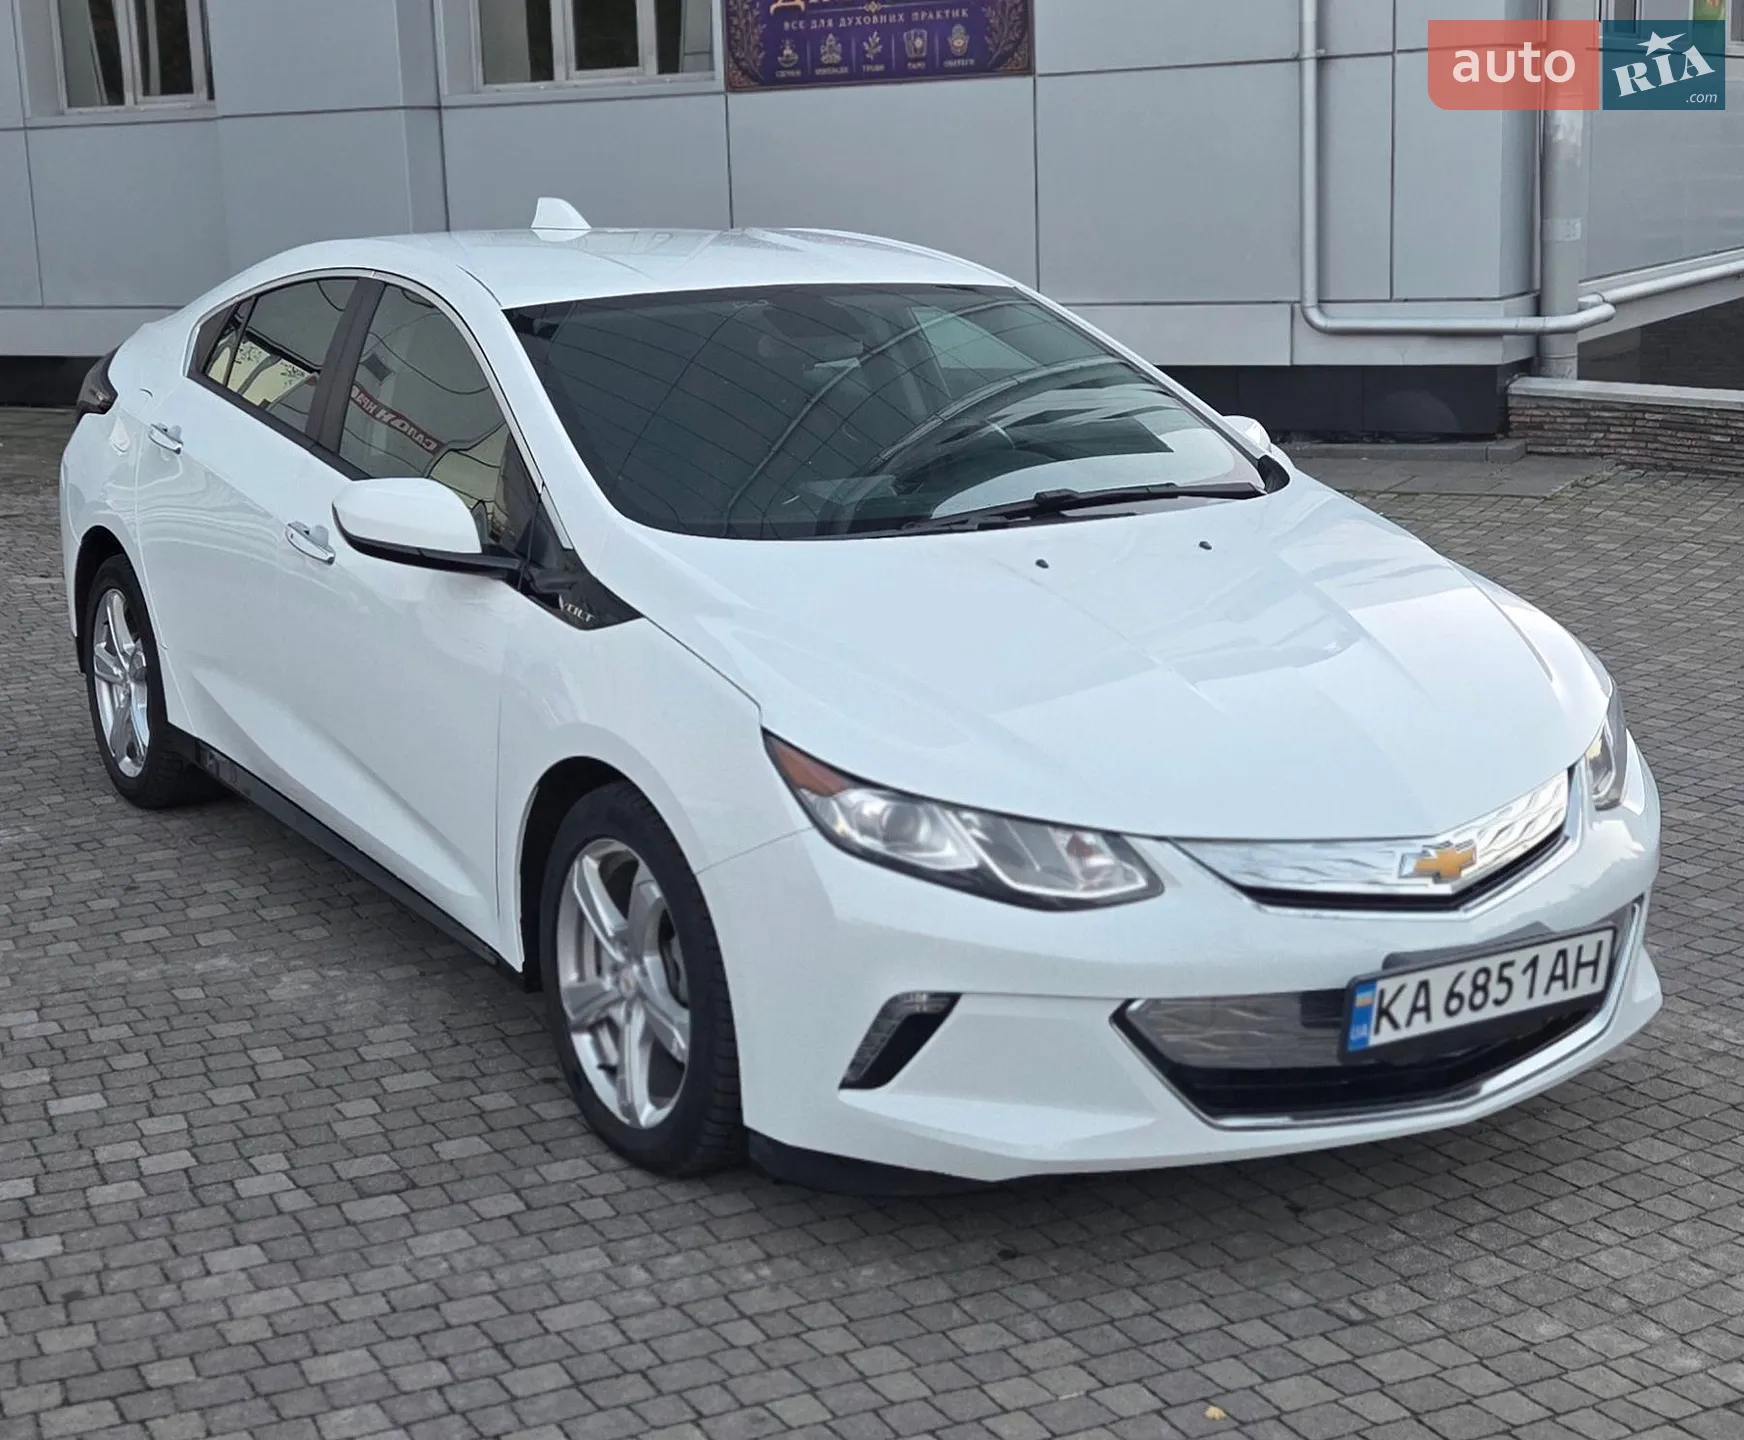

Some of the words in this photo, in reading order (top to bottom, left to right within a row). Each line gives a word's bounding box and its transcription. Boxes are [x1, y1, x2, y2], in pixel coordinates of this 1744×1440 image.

[810, 18, 834, 29] ДЛЯ
[839, 12, 905, 28] ДУХОВНИХ
[911, 8, 969, 21] ПРАКТИК
[1374, 978, 1432, 1036] KA
[1443, 954, 1540, 1018] 6851
[1544, 939, 1604, 996] AH
